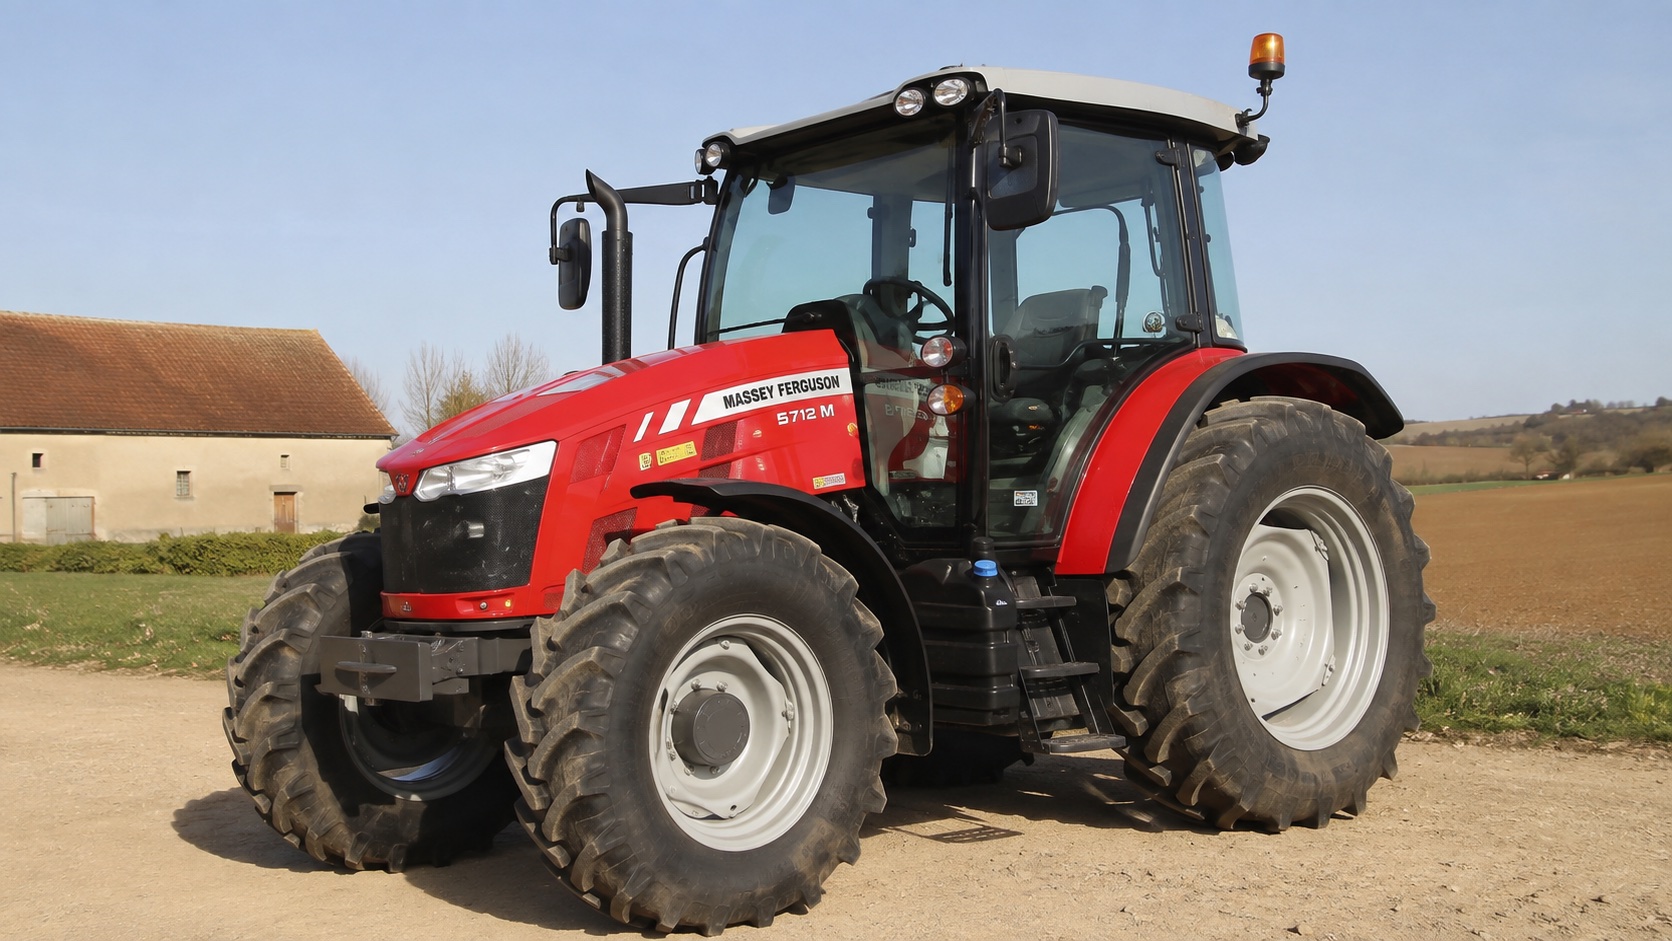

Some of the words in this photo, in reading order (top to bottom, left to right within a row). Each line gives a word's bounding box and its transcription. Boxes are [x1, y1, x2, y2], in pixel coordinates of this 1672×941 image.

[723, 385, 774, 409] MASSEY
[777, 375, 840, 397] FERGUSON
[777, 407, 817, 426] 5712
[820, 404, 835, 418] M
